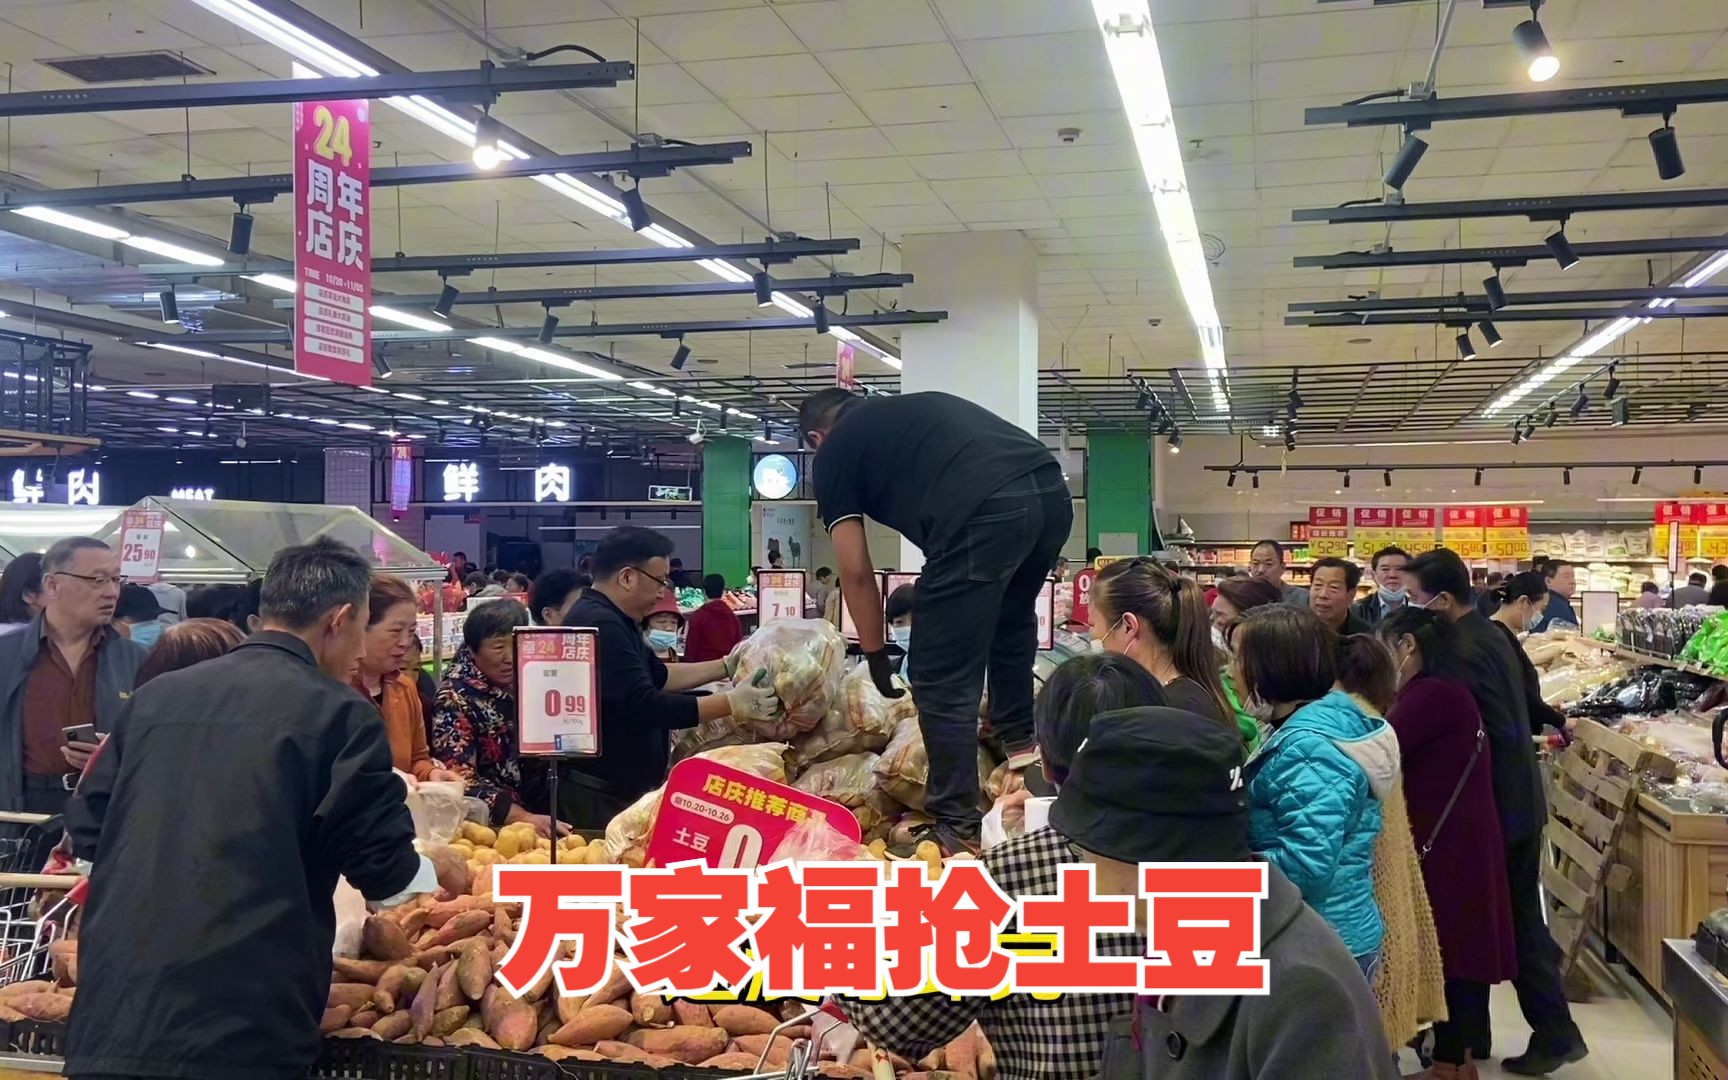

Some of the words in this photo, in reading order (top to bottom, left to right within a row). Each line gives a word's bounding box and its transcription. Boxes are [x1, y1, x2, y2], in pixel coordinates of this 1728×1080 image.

[313, 105, 353, 167] 24
[307, 158, 364, 221] 周年
[306, 208, 364, 271] 店庆
[442, 461, 571, 503] 鲜肉
[123, 544, 143, 562] 25
[772, 603, 780, 617] 7
[785, 606, 796, 616] 10
[538, 640, 555, 655] 24
[561, 646, 590, 660] 店庆
[545, 689, 561, 717] 0
[565, 695, 585, 713] 99
[672, 827, 710, 853] 土豆
